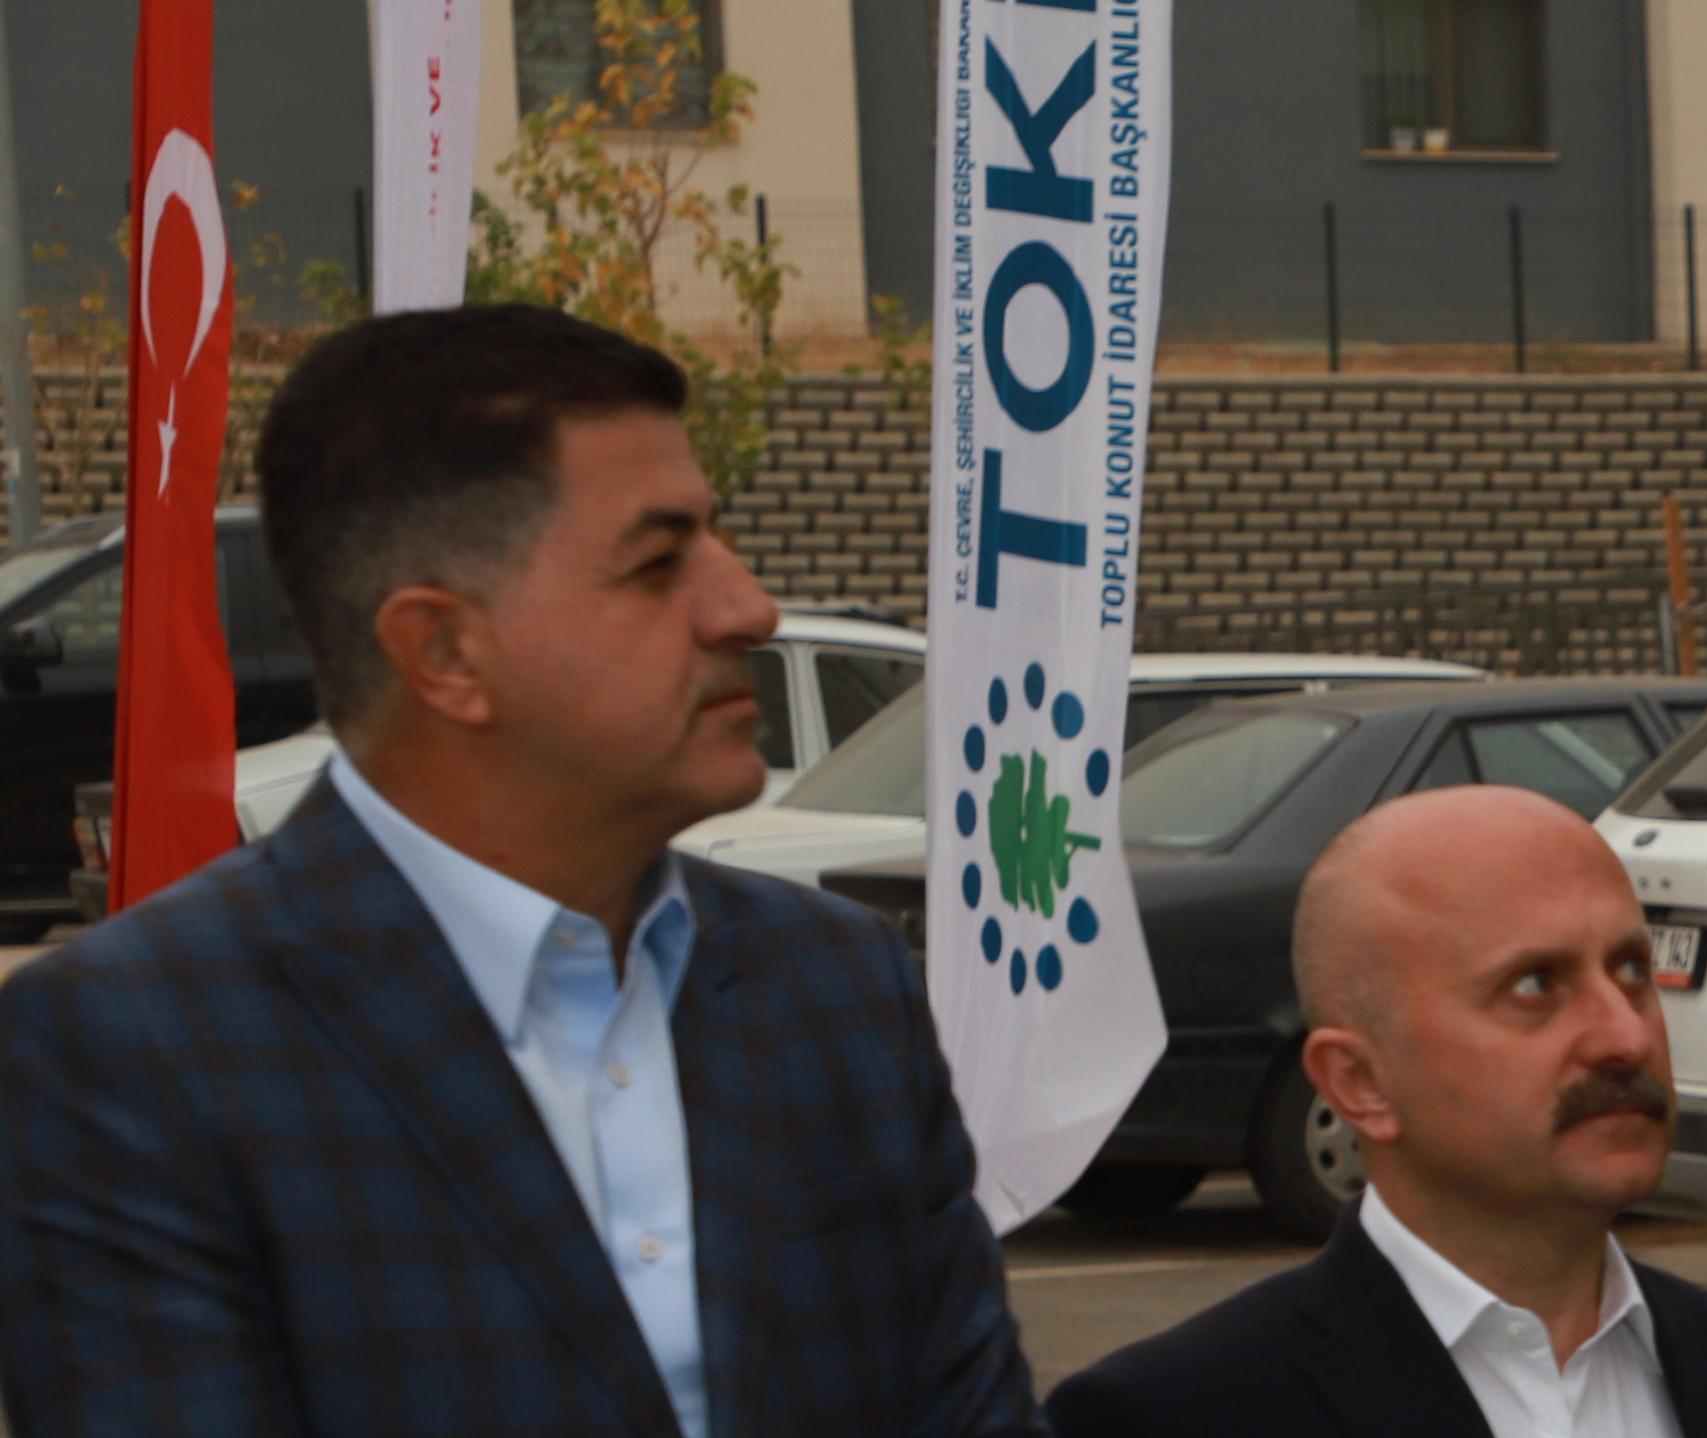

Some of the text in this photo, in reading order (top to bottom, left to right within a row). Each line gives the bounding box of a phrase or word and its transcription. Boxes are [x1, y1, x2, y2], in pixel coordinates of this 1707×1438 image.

[953, 234, 974, 301] İKLİM
[955, 307, 975, 336] VE
[1101, 0, 1148, 628] TOPLU KONUT İDARESİ BAŞKANLI
[953, 342, 977, 470] ŞEHİRCİLİK
[956, 476, 976, 558] ÇEVRE,
